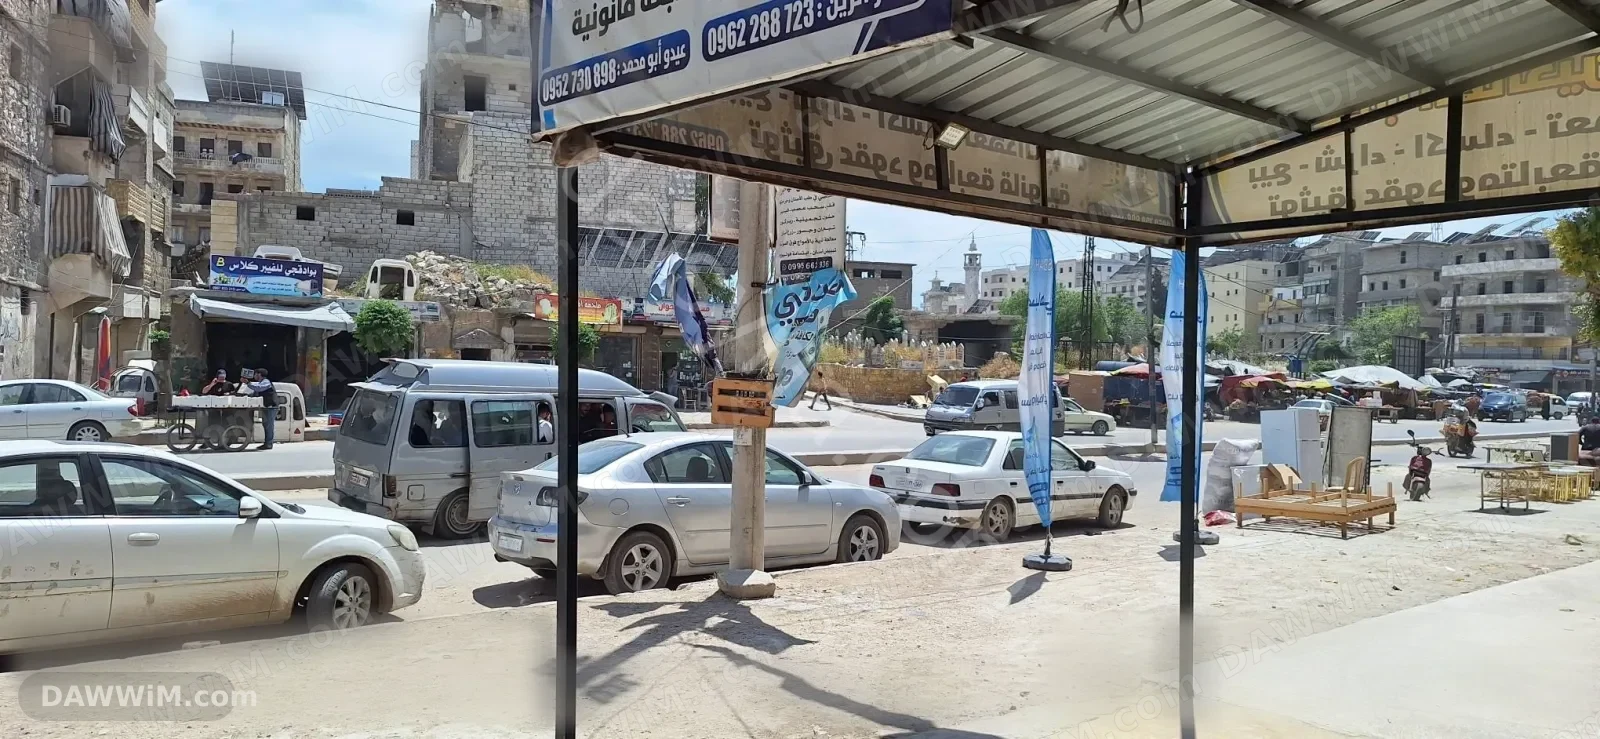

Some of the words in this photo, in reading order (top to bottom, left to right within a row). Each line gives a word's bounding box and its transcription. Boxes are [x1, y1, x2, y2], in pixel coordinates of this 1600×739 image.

[707, 18, 746, 56] 0962
[750, 7, 781, 44] 288
[784, 0, 815, 34] 723
[647, 38, 663, 74] أبو
[663, 43, 686, 69] عيدو
[571, 65, 591, 94] 730
[593, 58, 617, 88] 898
[542, 72, 569, 102] 0952
[216, 256, 225, 268] B
[228, 260, 259, 271] كلاس
[260, 263, 283, 274] للفيبر
[284, 265, 317, 278] بوادقجي
